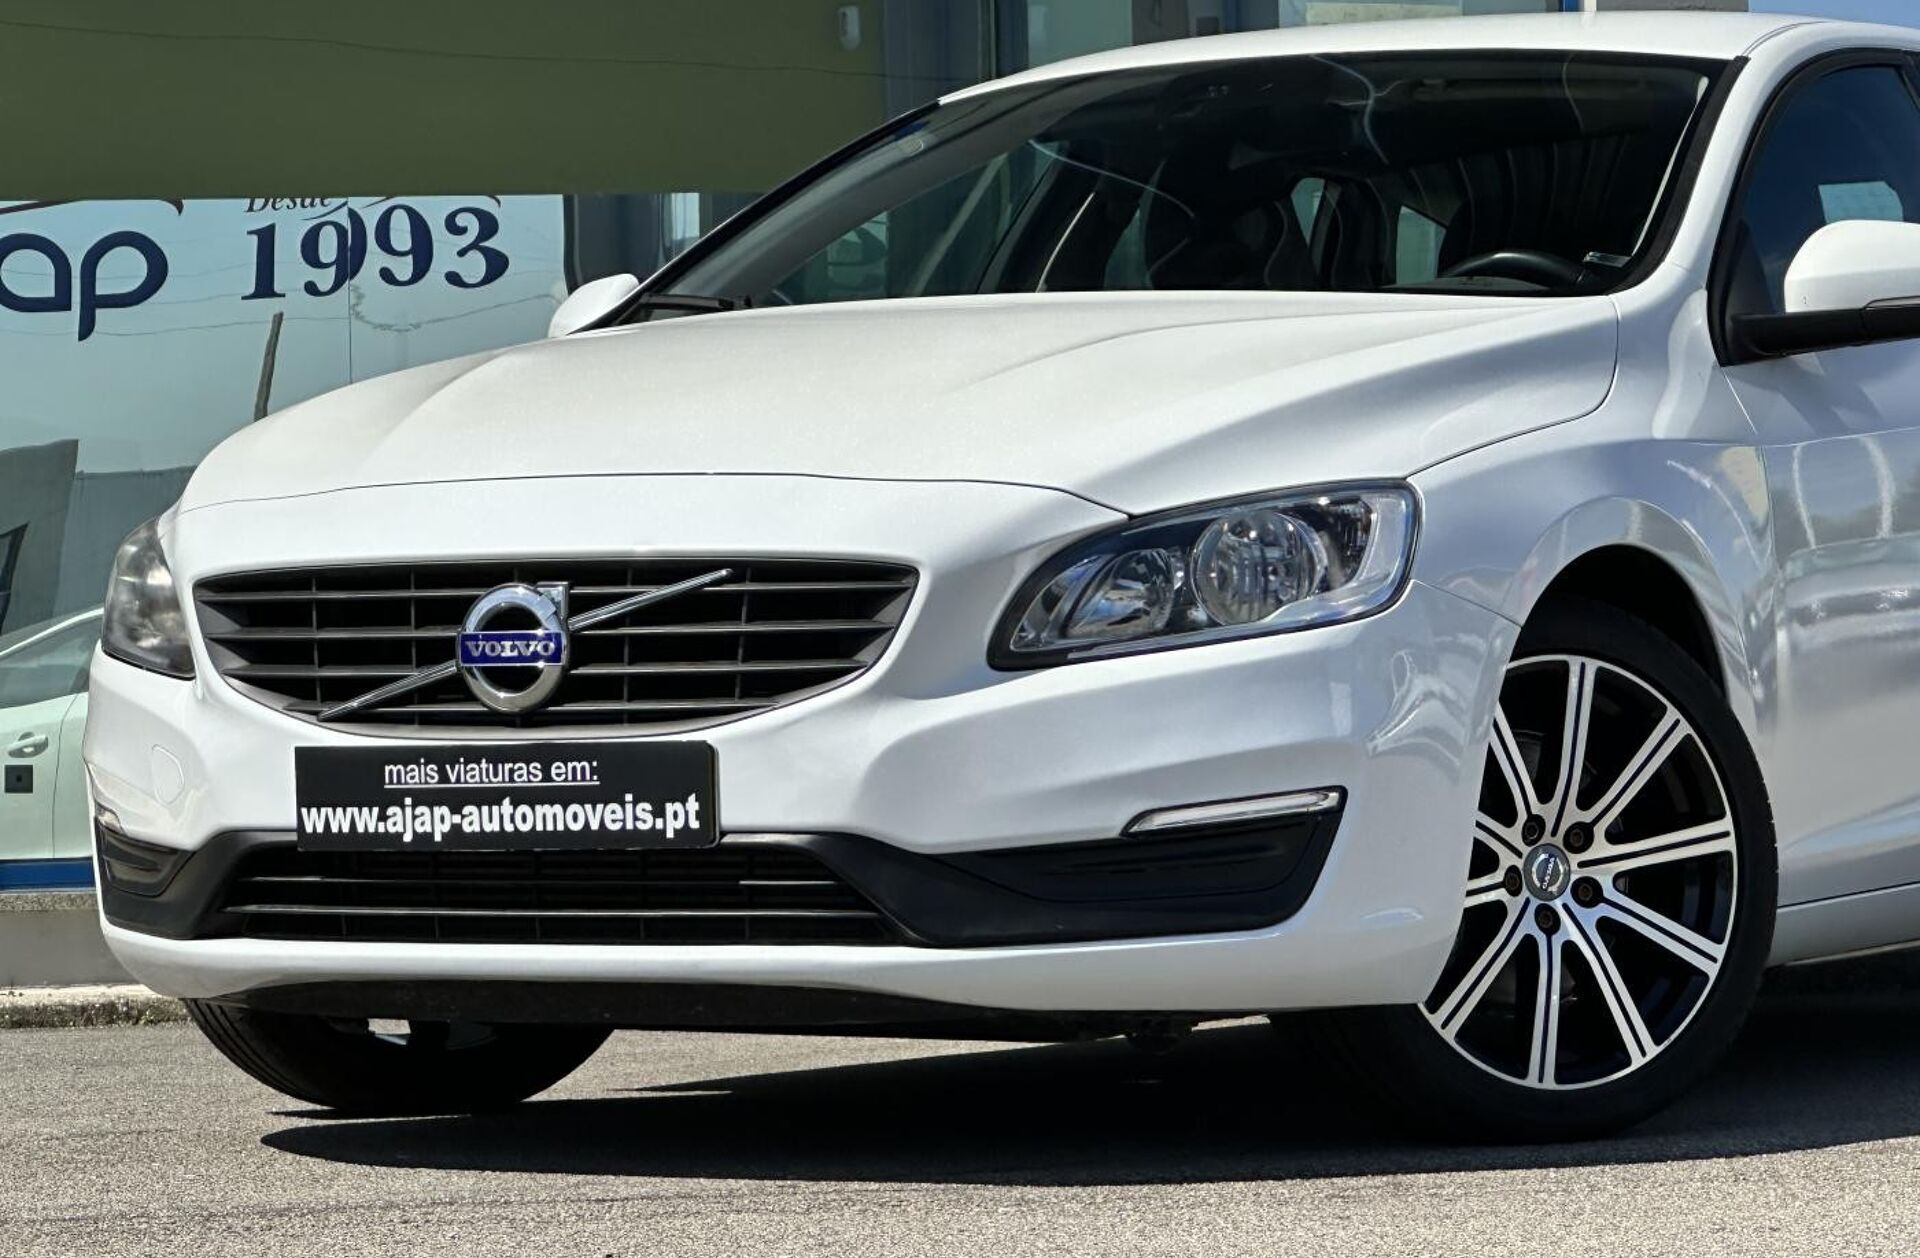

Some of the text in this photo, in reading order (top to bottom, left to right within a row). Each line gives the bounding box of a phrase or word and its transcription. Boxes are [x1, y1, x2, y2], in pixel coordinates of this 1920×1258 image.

[241, 204, 510, 300] 1993
[465, 640, 556, 657] VOLVO
[384, 757, 599, 784] mais viaturas em:
[301, 793, 700, 842] www.ajap-automoveis.pt
